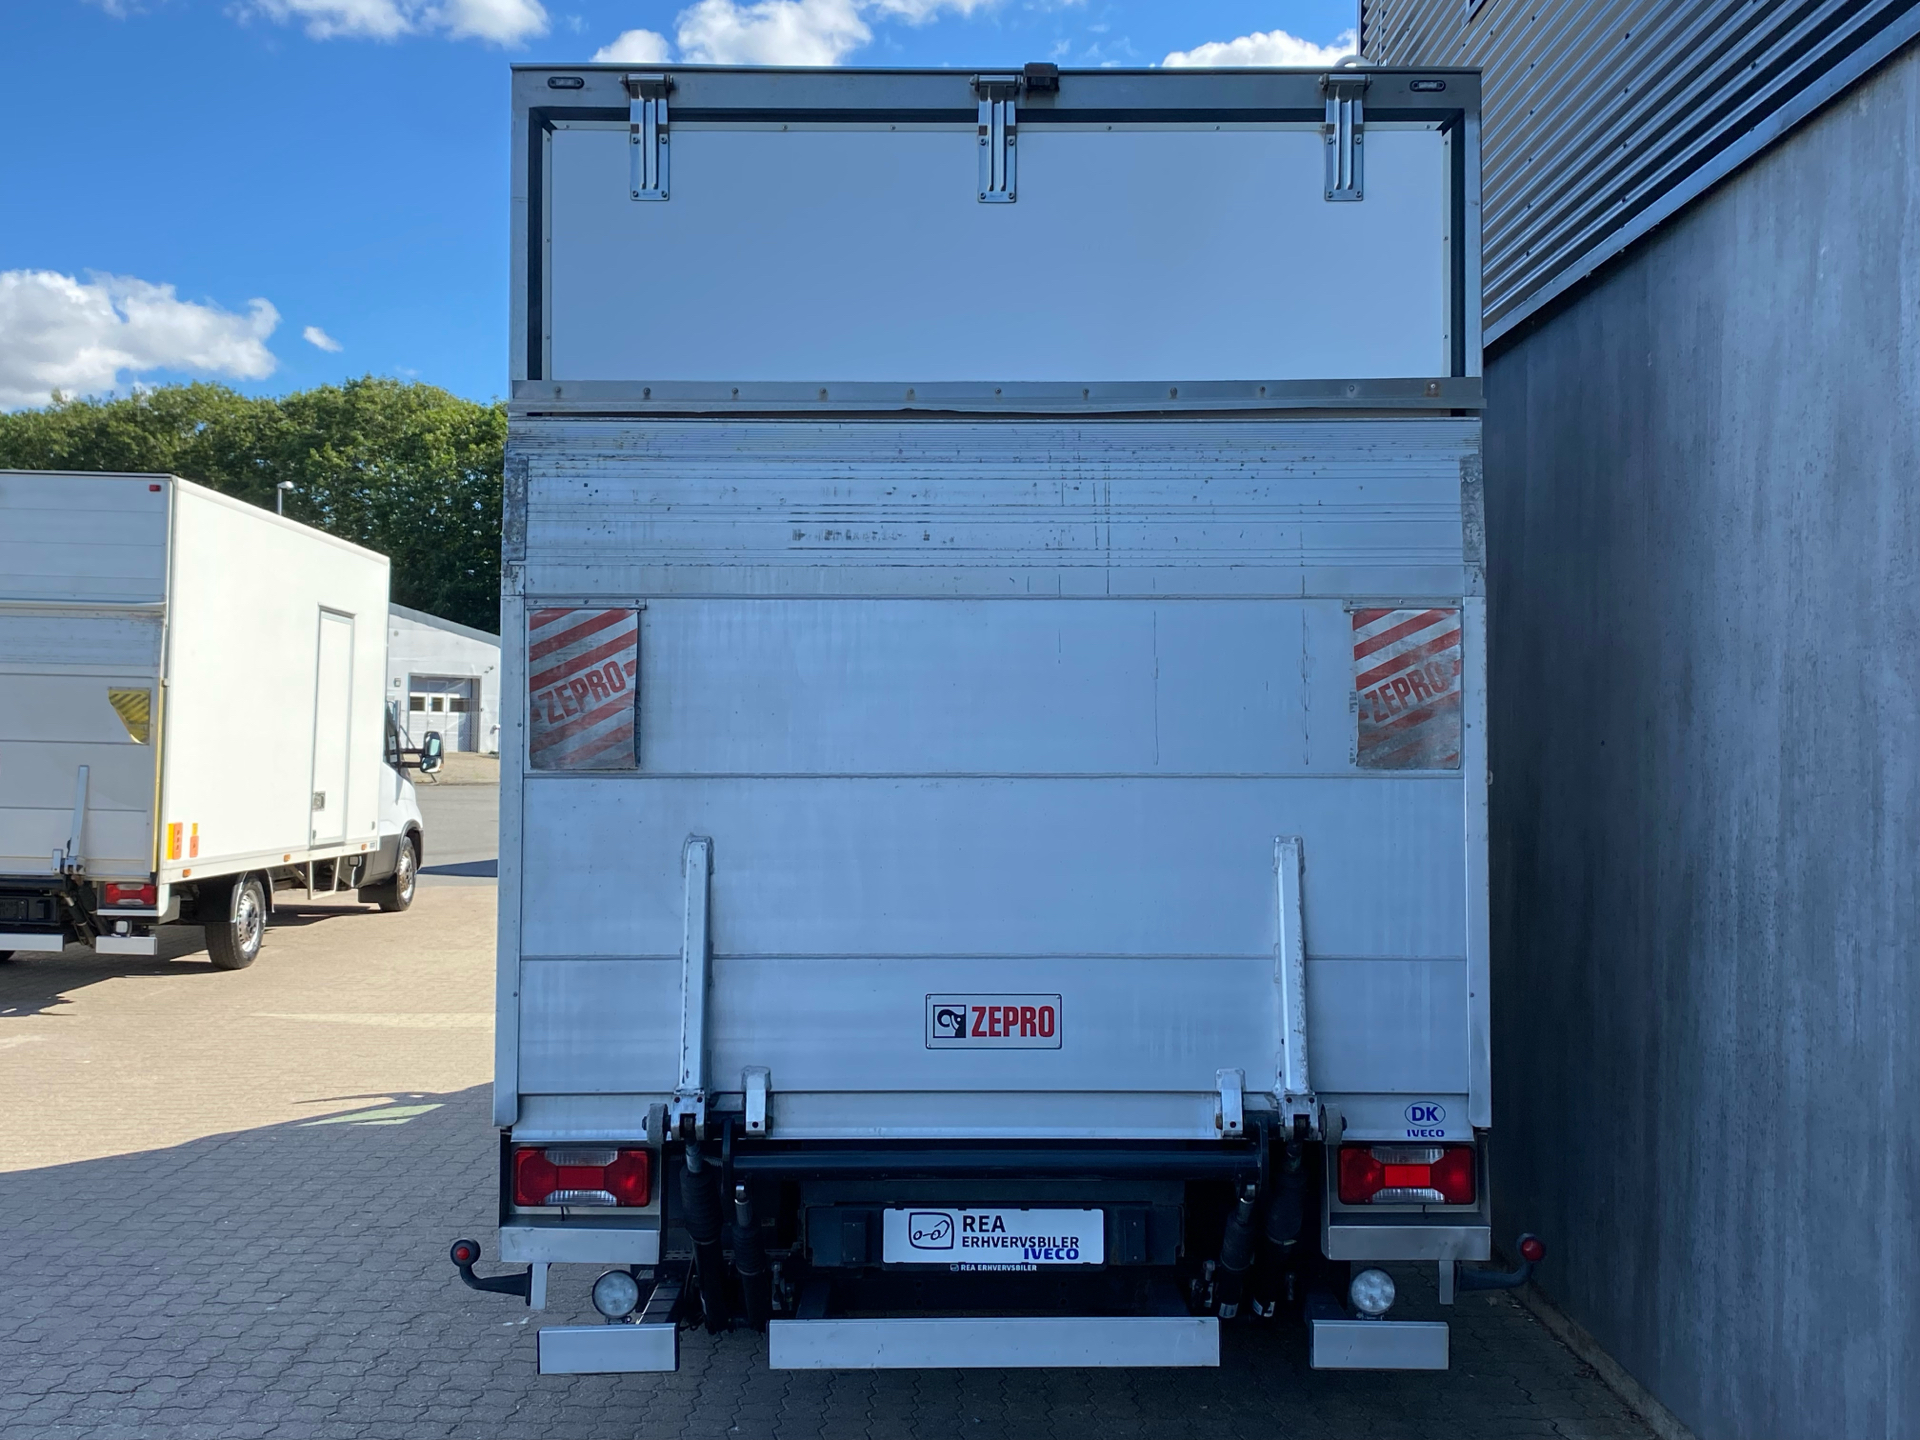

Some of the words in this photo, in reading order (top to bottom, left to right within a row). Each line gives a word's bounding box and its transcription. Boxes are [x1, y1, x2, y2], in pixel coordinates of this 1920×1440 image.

[538, 660, 626, 725] ZEPRO
[1364, 661, 1450, 724] ZEPRO
[971, 1005, 1055, 1038] ZEPRO
[1411, 1106, 1440, 1122] DK
[1406, 1129, 1445, 1138] IVECO
[962, 1215, 1007, 1233] REA
[961, 1236, 1080, 1249] ERHVERVSBILER
[1023, 1248, 1080, 1260] IVECO
[960, 1264, 976, 1272] REA
[977, 1264, 1038, 1272] ERHVERVSBILER
